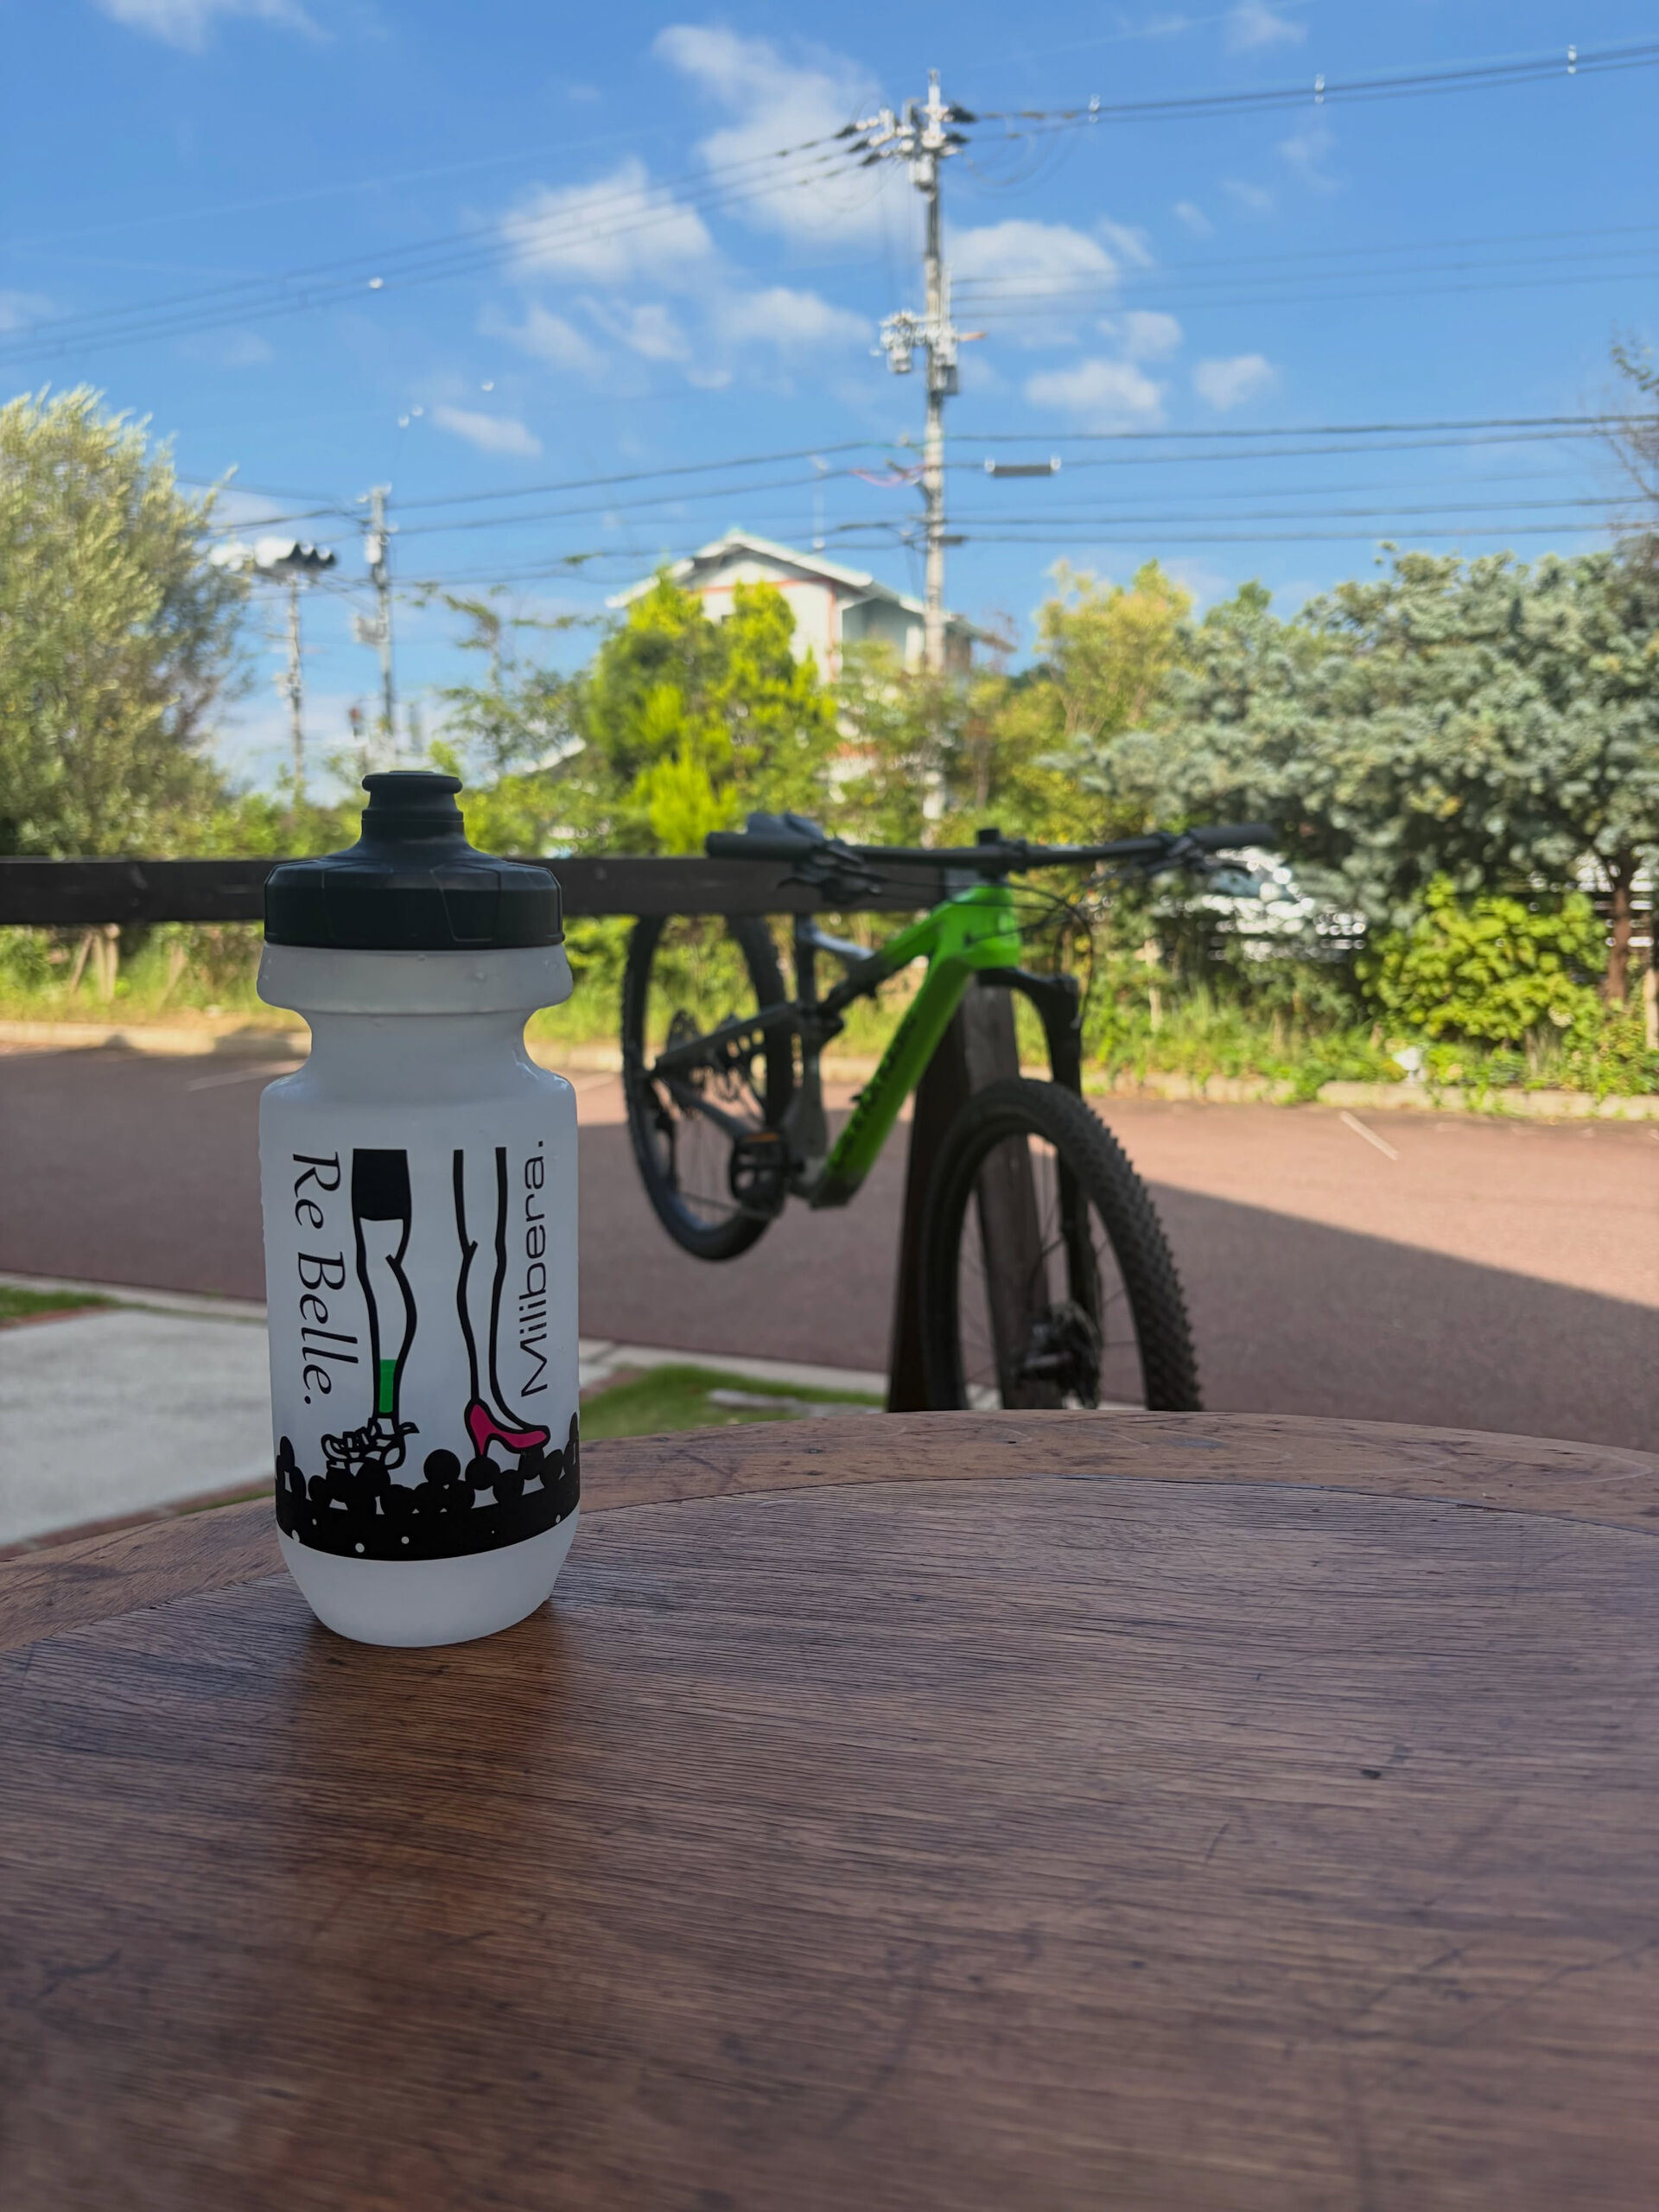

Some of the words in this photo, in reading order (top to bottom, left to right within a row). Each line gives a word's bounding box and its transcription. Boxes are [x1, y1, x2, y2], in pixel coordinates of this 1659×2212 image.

[292, 1151, 341, 1230] Re
[297, 1251, 359, 1405] Belle.
[518, 1140, 548, 1398] Milibera.
